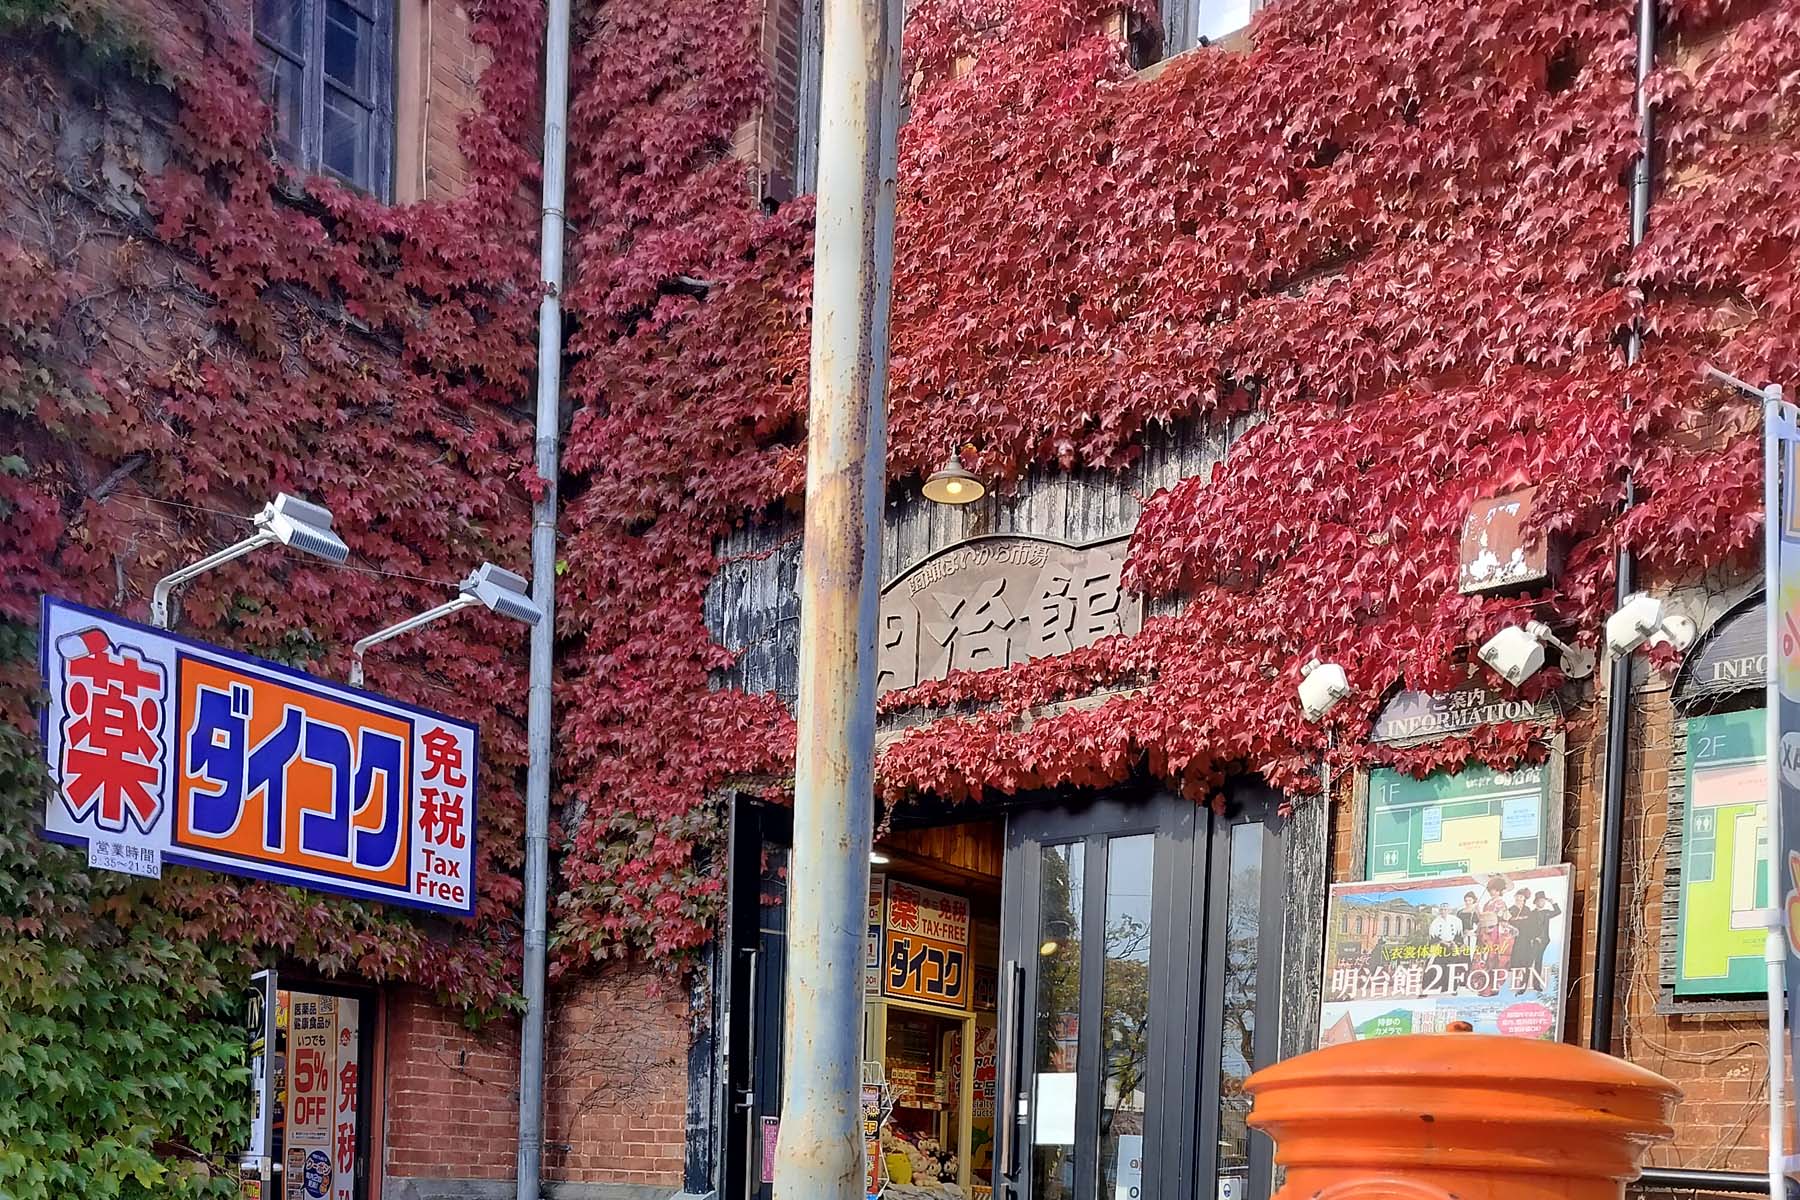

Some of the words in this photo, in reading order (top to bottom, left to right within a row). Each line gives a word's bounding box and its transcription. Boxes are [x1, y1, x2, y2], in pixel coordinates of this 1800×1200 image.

[907, 543, 1050, 597] 函館はいから市場
[60, 628, 164, 826] 薬
[1387, 700, 1535, 737] INFORMATION
[1696, 735, 1726, 759] 2F
[188, 683, 404, 872] ダイコク
[419, 726, 467, 849] 免税
[1379, 783, 1401, 803] 1F
[95, 840, 155, 864] 営業時間
[421, 848, 461, 878] Tax
[416, 872, 465, 903] Free
[890, 883, 920, 932] 薬
[938, 897, 966, 924] 免税
[922, 919, 966, 942] TAX-FREE
[890, 938, 965, 997] ダイコク
[293, 1016, 331, 1030] 健康食品が
[294, 1002, 317, 1016] 医薬品
[297, 1035, 326, 1047] いつでも
[294, 1049, 328, 1093] 5%
[294, 1096, 327, 1125] OFF
